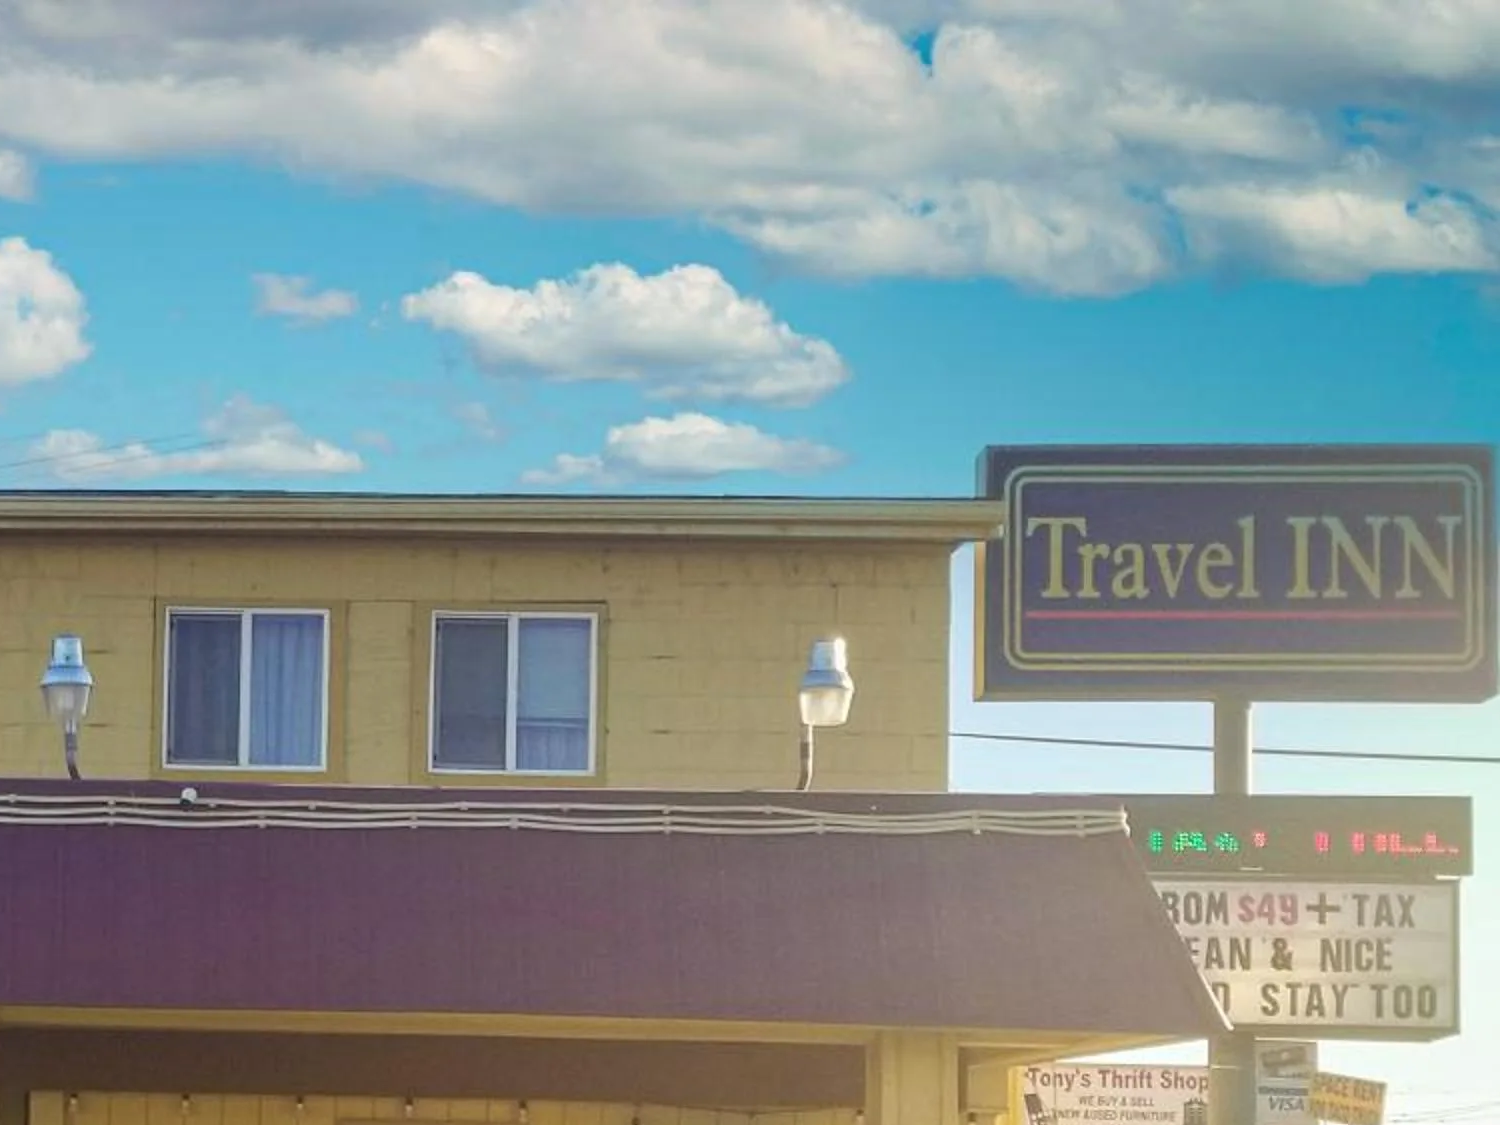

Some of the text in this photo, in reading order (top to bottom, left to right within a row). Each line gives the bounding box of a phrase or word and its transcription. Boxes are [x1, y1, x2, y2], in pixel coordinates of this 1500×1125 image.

[1026, 515, 1462, 599] Travel INN
[1162, 890, 1228, 925] ROM
[1352, 893, 1416, 928] TAX
[1184, 936, 1393, 972] EAN & NICE
[1260, 981, 1351, 1018] STAY
[1370, 983, 1438, 1019] TOO
[1025, 1067, 1208, 1094] Tony's Thrift Shop
[1268, 1096, 1305, 1111] VISA
